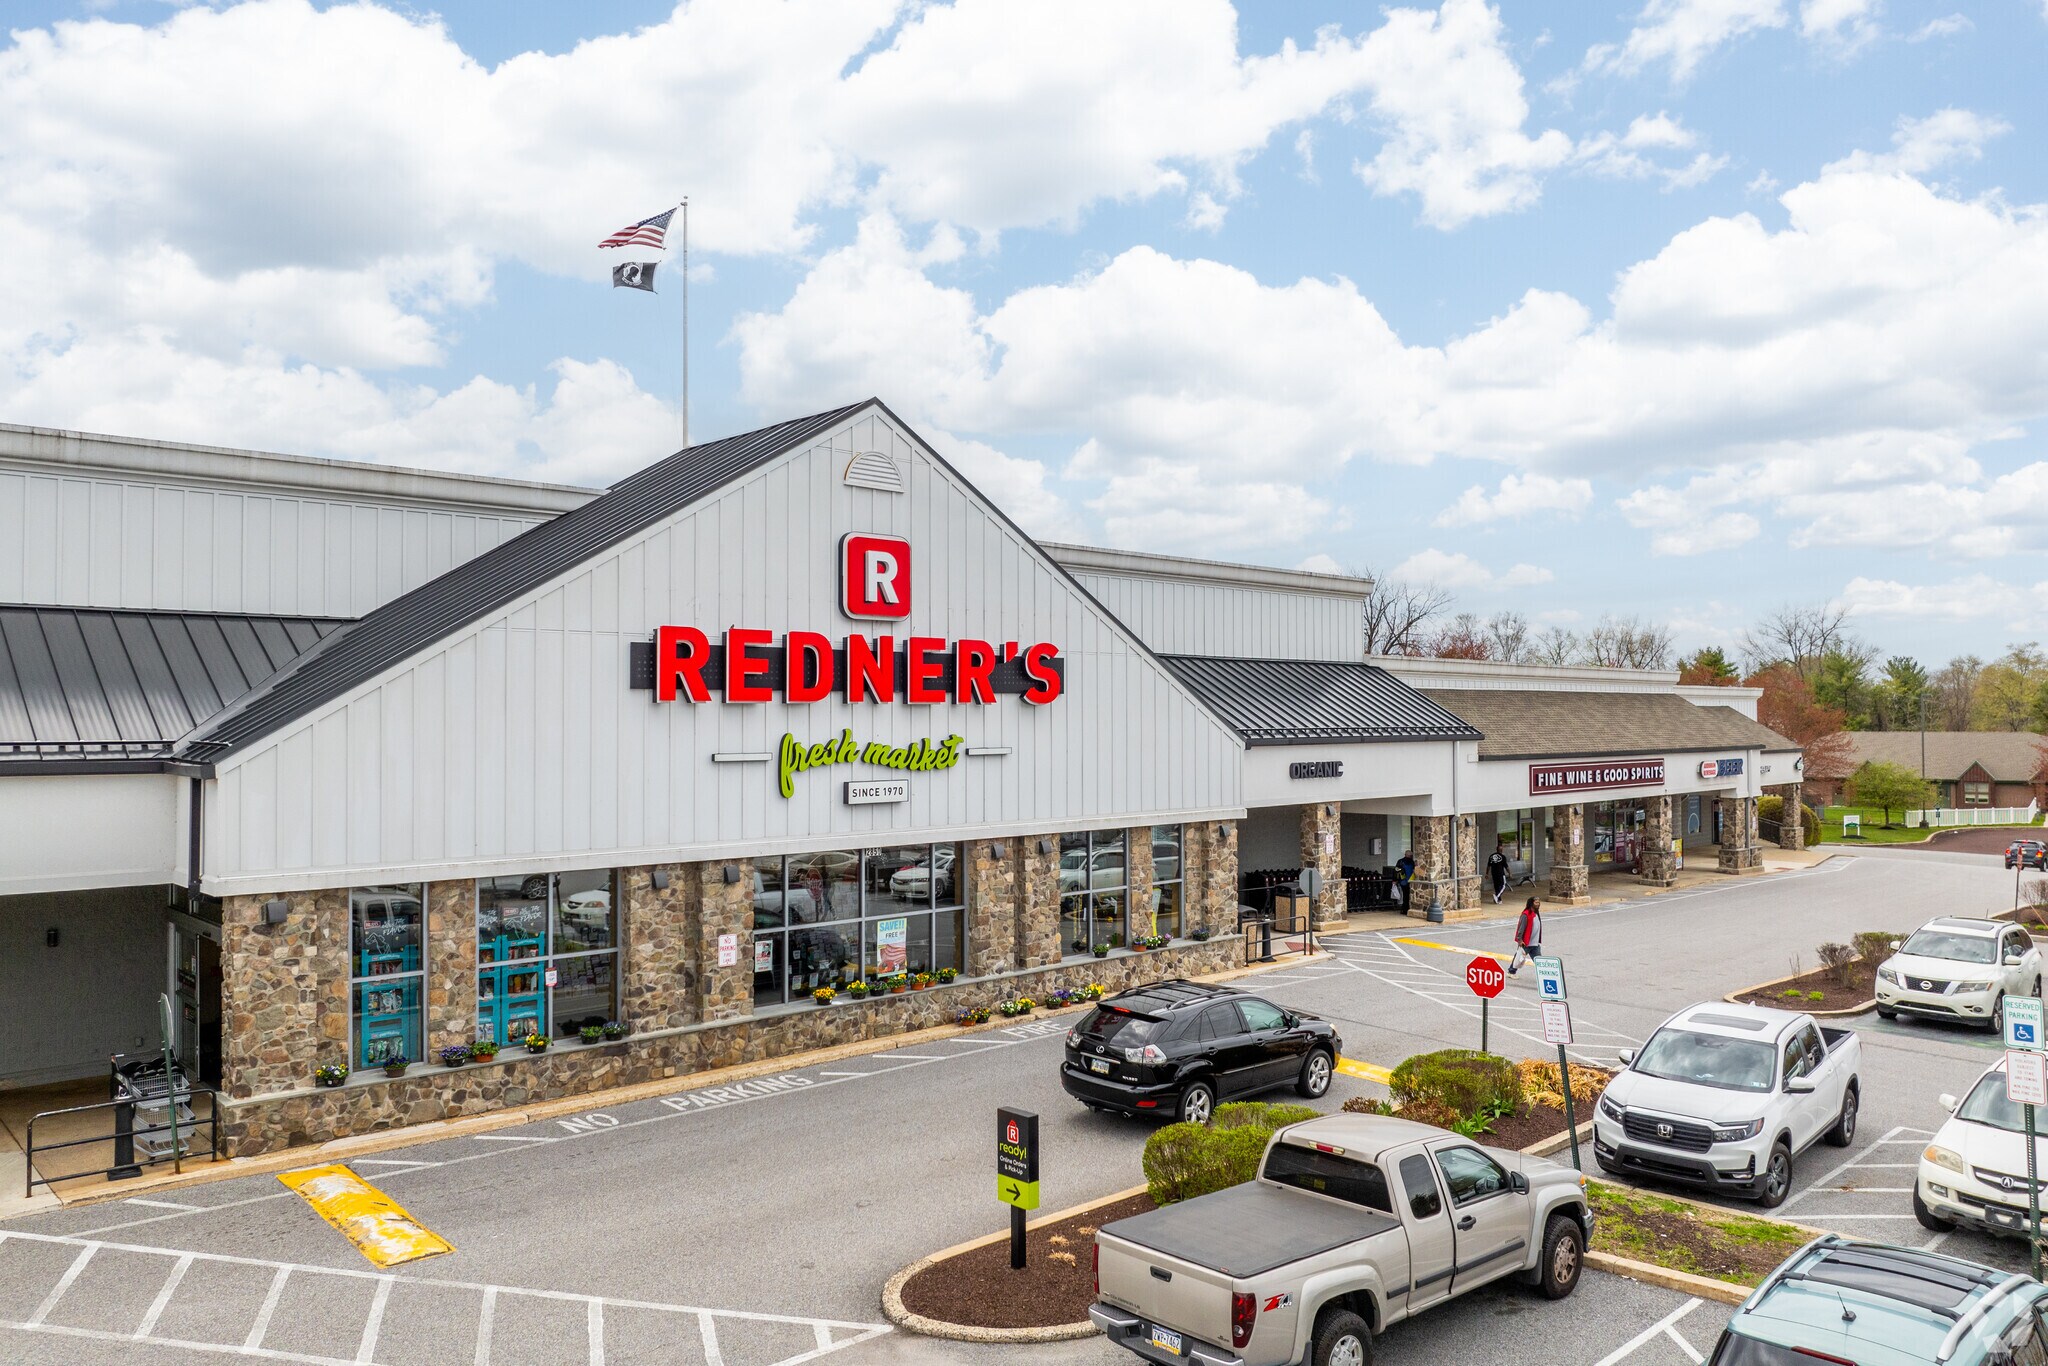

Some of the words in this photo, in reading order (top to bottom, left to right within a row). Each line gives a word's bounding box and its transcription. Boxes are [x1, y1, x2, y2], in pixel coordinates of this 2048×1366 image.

[864, 549, 900, 605] R
[653, 625, 1061, 706] REDNER'S
[778, 728, 861, 799] fresh
[861, 733, 965, 771] market
[1289, 760, 1344, 779] ORGANIC
[1537, 772, 1563, 787] FINE
[1565, 770, 1593, 785] WINE
[1595, 769, 1601, 783] &
[1603, 767, 1629, 782] GOOD
[1631, 765, 1664, 780] SPIRITS
[852, 787, 880, 798] SINCE
[883, 786, 904, 796] 1970
[879, 919, 905, 932] SAVE!!
[885, 931, 898, 939] FREE
[1536, 961, 1560, 969] RESERVED
[1468, 968, 1502, 986] STOP
[2006, 1000, 2040, 1011] RESERVED
[2008, 1011, 2038, 1021] PARKING
[1000, 1020, 1062, 1039] FIRE
[556, 1112, 620, 1134] NO
[659, 1073, 815, 1112] PARKING
[1000, 1142, 1027, 1160] ready!
